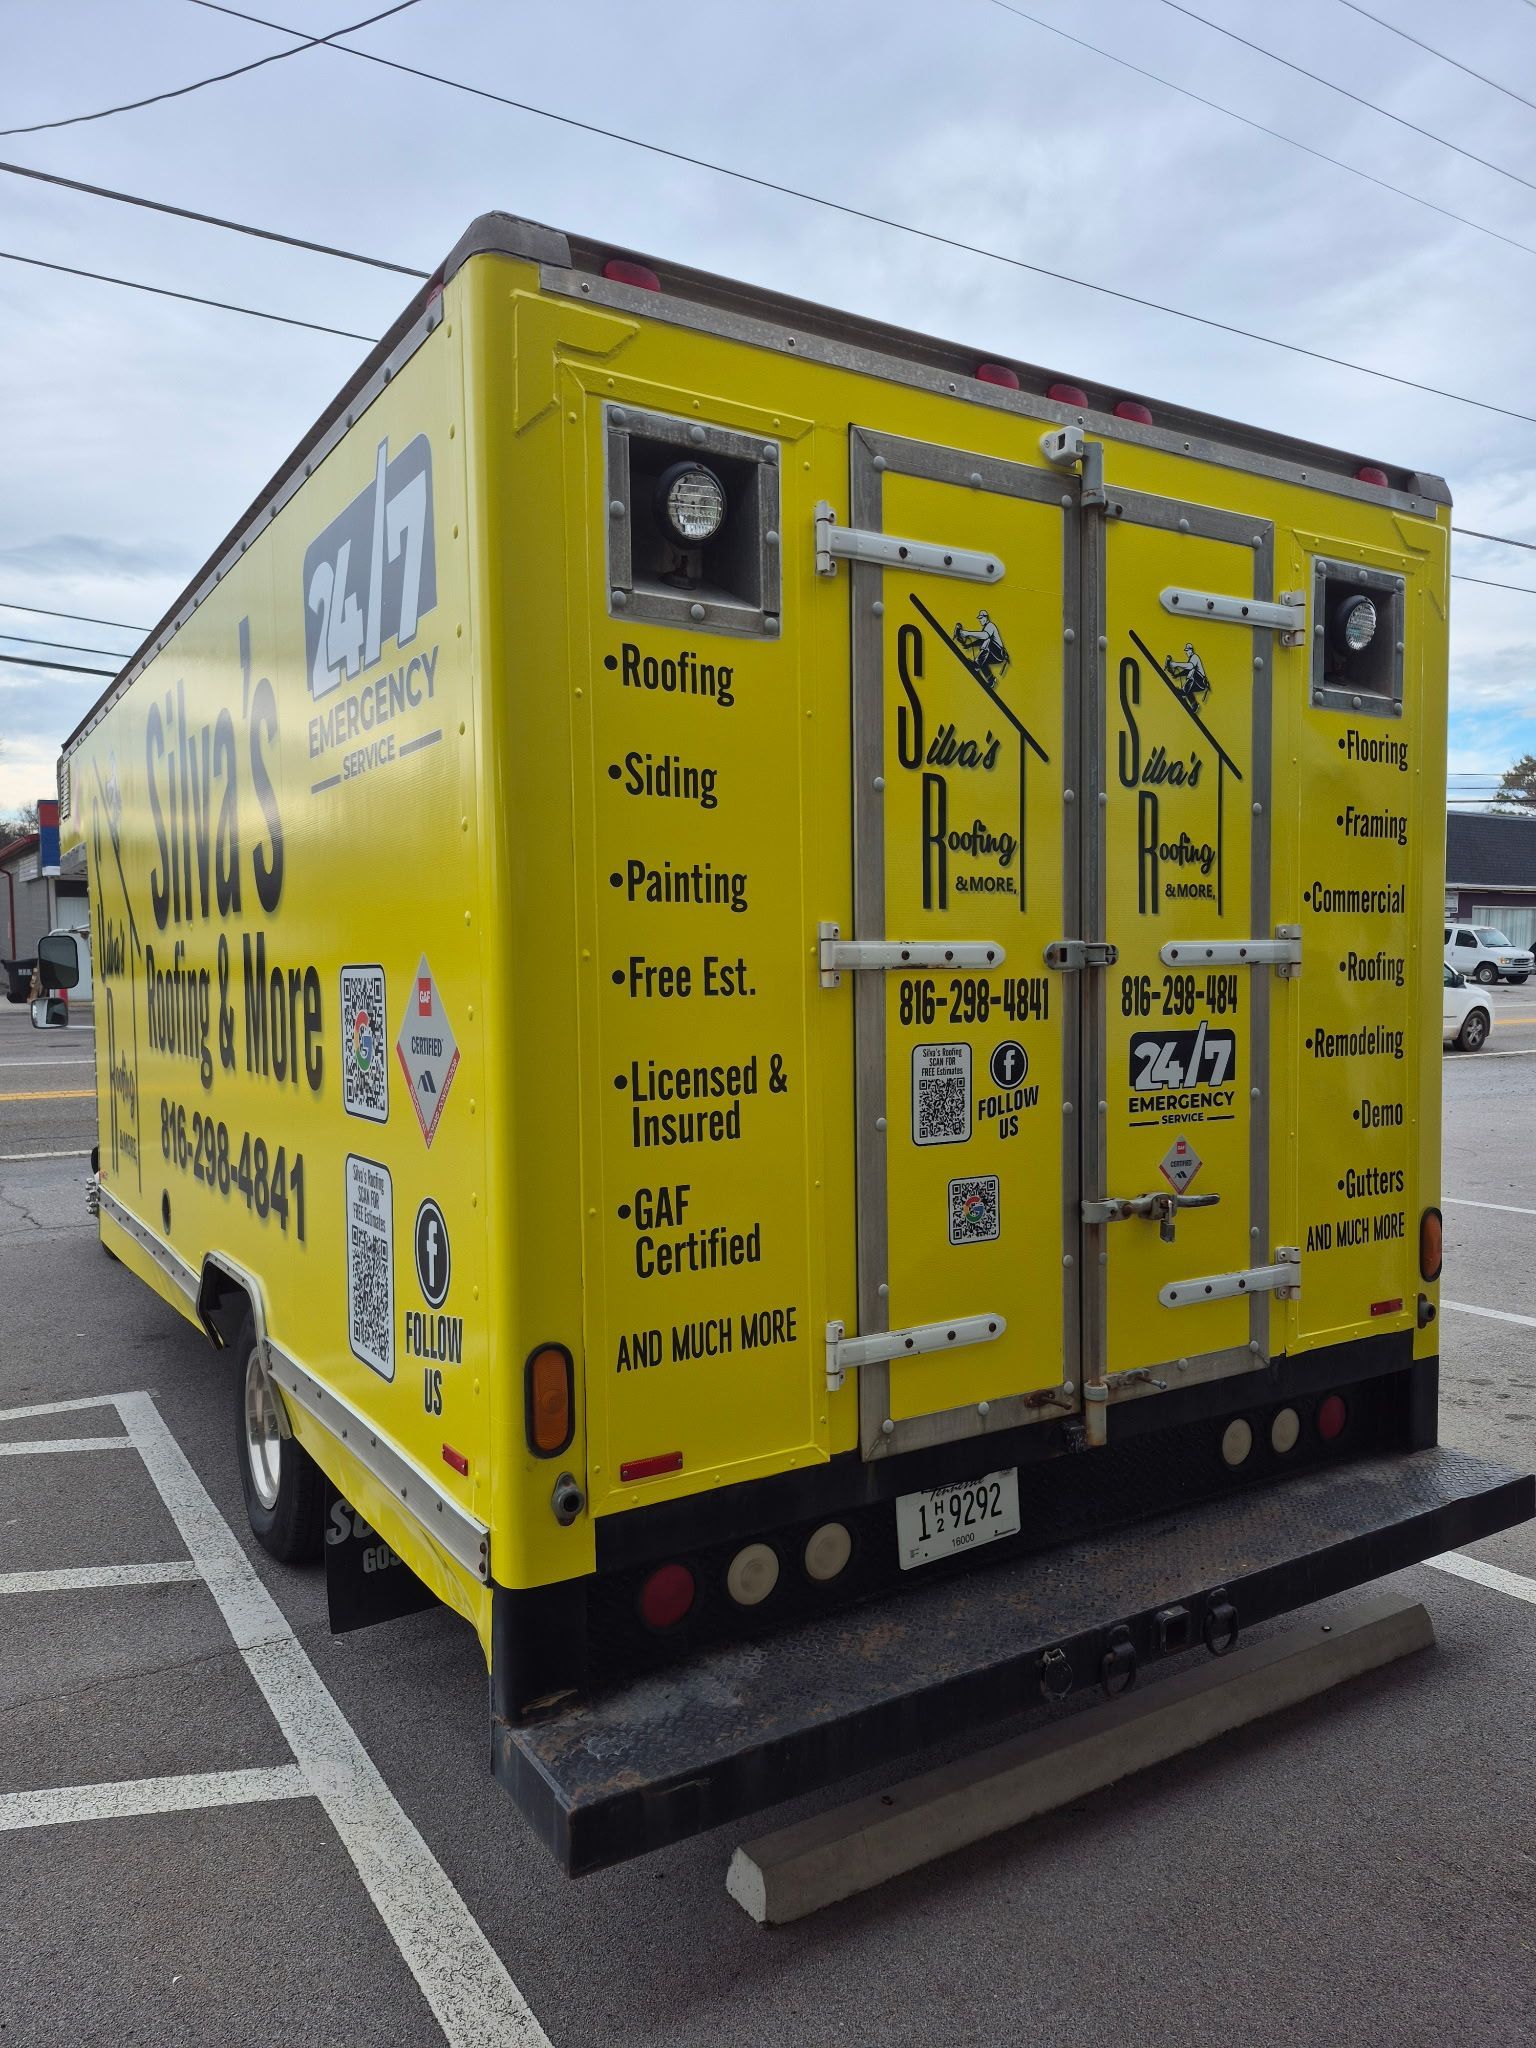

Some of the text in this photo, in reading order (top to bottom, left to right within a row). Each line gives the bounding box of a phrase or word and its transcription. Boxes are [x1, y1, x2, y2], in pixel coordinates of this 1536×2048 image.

[309, 436, 429, 700] 24/7
[621, 643, 735, 708] Roofing
[897, 623, 1000, 770] Silva's
[309, 645, 439, 759] EMERGENCY
[1118, 656, 1203, 788] Silva's
[343, 734, 396, 780] SERVICE
[1346, 729, 1409, 772] Flooring
[146, 615, 284, 930] Silva's
[624, 751, 718, 809] Siding
[922, 772, 1017, 910] Roofing
[1345, 805, 1408, 846] Framing
[1138, 790, 1216, 914] Roofing
[626, 859, 749, 912] Painting
[1311, 881, 1406, 914] Commercial
[629, 956, 756, 998] Free Est.
[1347, 951, 1405, 987] Roofing
[146, 931, 323, 1091] Roofing & More
[420, 990, 431, 1004] GAF
[899, 977, 1050, 1025] 816-298-4841
[1121, 974, 1238, 1017] 816-298-484
[411, 1036, 443, 1057] CERTIFIED
[929, 1057, 956, 1067] SCAN FOR
[942, 1048, 963, 1058] Roofing
[1133, 1021, 1233, 1092] 24/7
[1314, 1025, 1405, 1060] Remodeling
[631, 1053, 788, 1102] Licensed &
[921, 1067, 964, 1077] FREE Estimates
[632, 1100, 741, 1147] Insured
[978, 1085, 1040, 1121] FOLLOW
[1128, 1091, 1235, 1113] EMERGENCY
[1161, 1112, 1205, 1125] SERVICE
[1361, 1099, 1404, 1129] Demo
[998, 1115, 1019, 1140] US
[160, 1097, 305, 1242] 816-298-4841
[352, 1163, 367, 1185] Silva's
[1345, 1167, 1405, 1199] Gutters
[353, 1202, 364, 1223] FREE
[357, 1185, 380, 1210] SCAN FOR
[634, 1184, 691, 1230] GAF
[635, 1222, 761, 1279] Certified
[1306, 1212, 1405, 1253] AND MUCH MORE
[406, 1312, 463, 1364] FOLLOW
[616, 1306, 797, 1373] AND MUCH MORE
[424, 1369, 443, 1416] US
[951, 1532, 976, 1548] 16000
